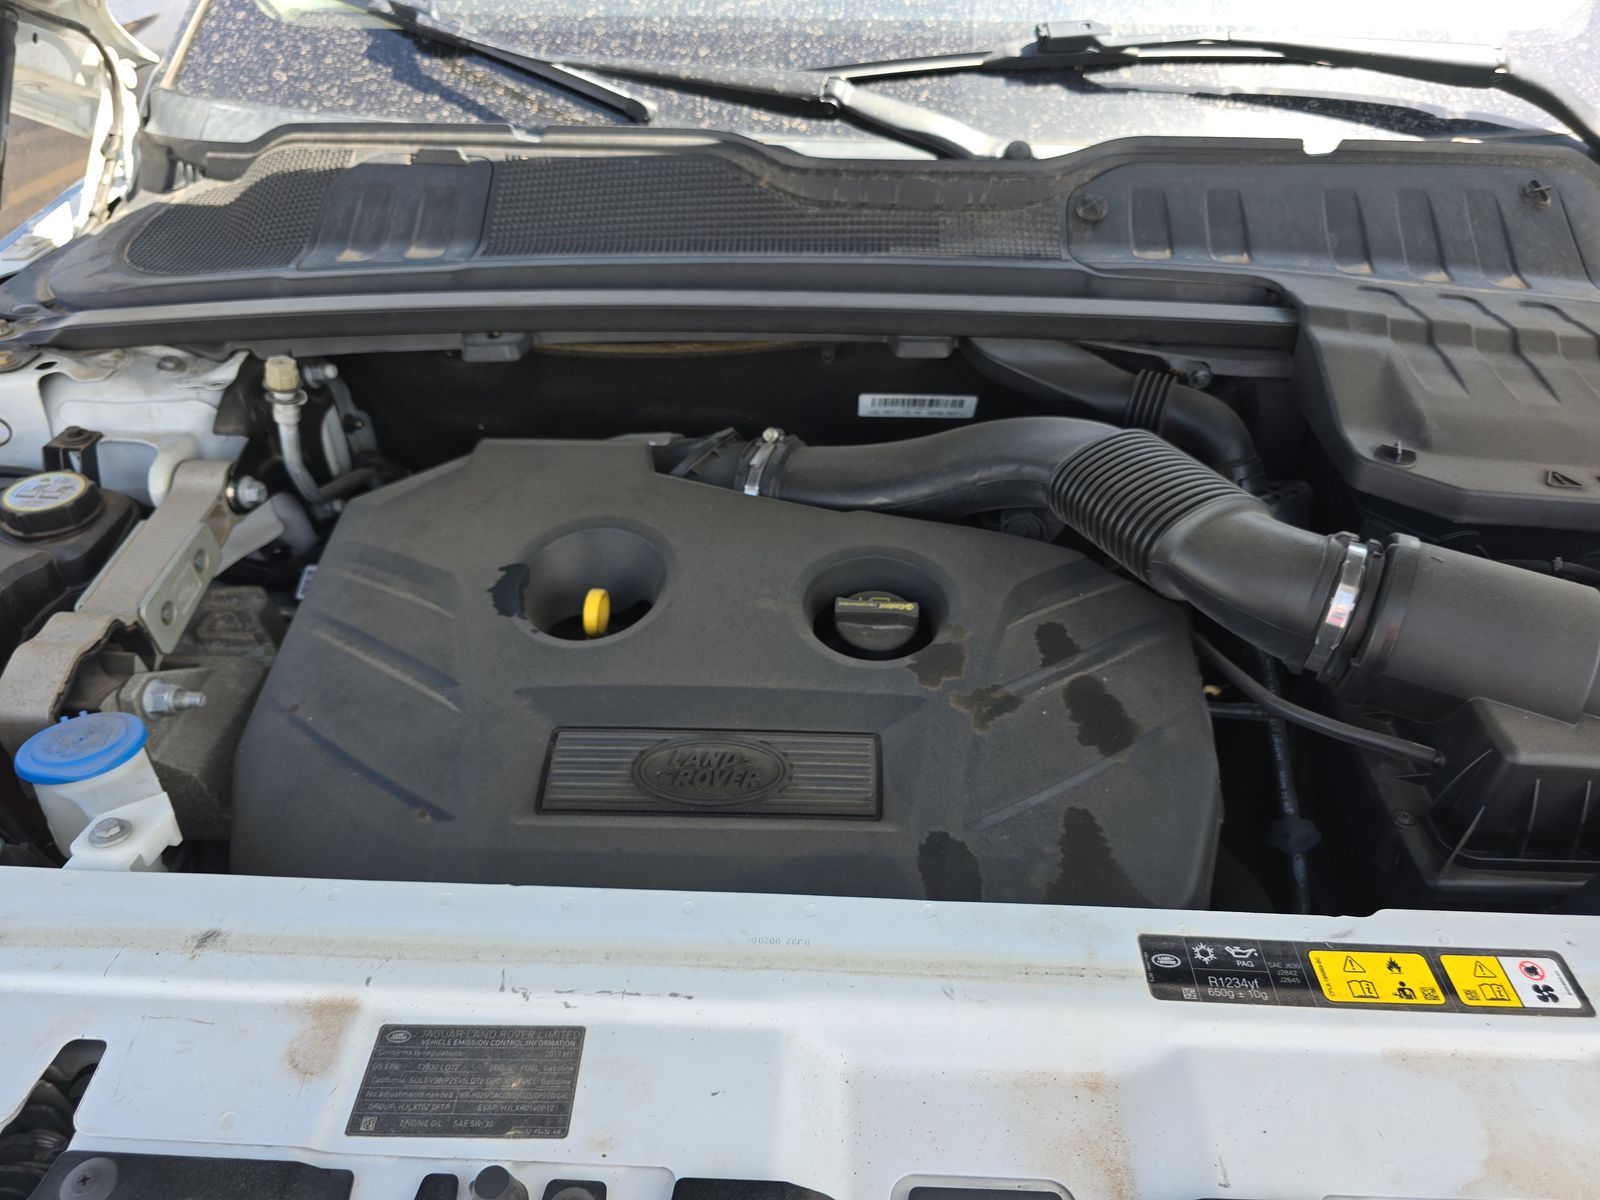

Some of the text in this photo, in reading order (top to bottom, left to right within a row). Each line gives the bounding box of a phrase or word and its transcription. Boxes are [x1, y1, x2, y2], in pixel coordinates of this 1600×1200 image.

[669, 750, 744, 767] LAND
[673, 768, 761, 788] ROVER
[1236, 960, 1255, 968] PAG
[1207, 976, 1260, 990] R1234yf
[1207, 987, 1235, 999] 650g
[1249, 989, 1269, 1000] 10g
[420, 1029, 581, 1040] JAGUAR LAND ROVER LIMITED
[451, 1039, 490, 1047] EMISSION
[491, 1039, 523, 1047] CONTROL
[524, 1039, 576, 1047] INFORMATION
[400, 1119, 430, 1128] ENGINE
[430, 1119, 442, 1128] OIL
